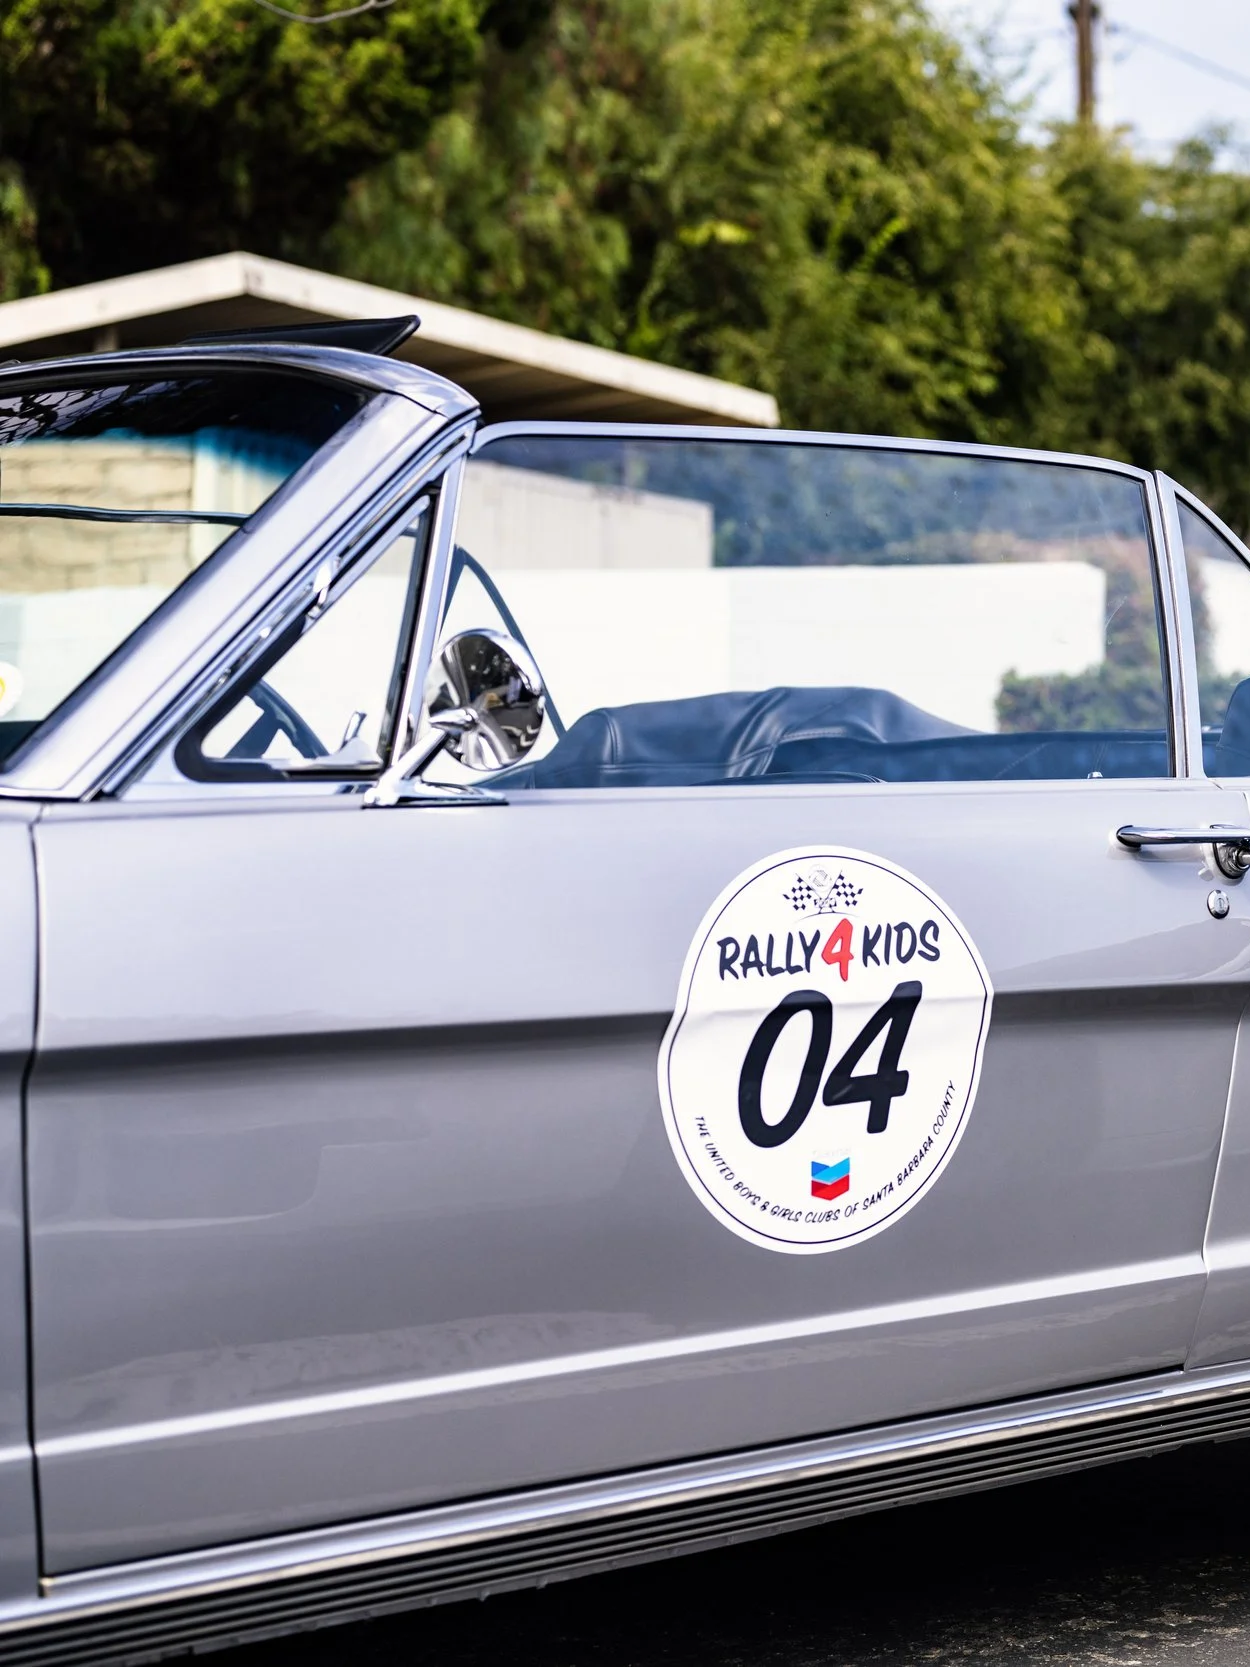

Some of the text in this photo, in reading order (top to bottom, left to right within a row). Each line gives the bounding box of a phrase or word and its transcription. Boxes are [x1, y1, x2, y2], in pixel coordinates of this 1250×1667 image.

[738, 980, 922, 1148] 04
[695, 1116, 711, 1137] THE
[705, 1143, 735, 1181] UNITED
[733, 1181, 761, 1205] BOYS
[770, 1205, 802, 1222] GIRLS
[804, 1209, 841, 1223] CLUBS
[844, 1202, 859, 1218] OF
[862, 1182, 894, 1211] SANTA
[897, 1136, 934, 1186] BARBARA
[932, 1080, 956, 1135] COUNTY
